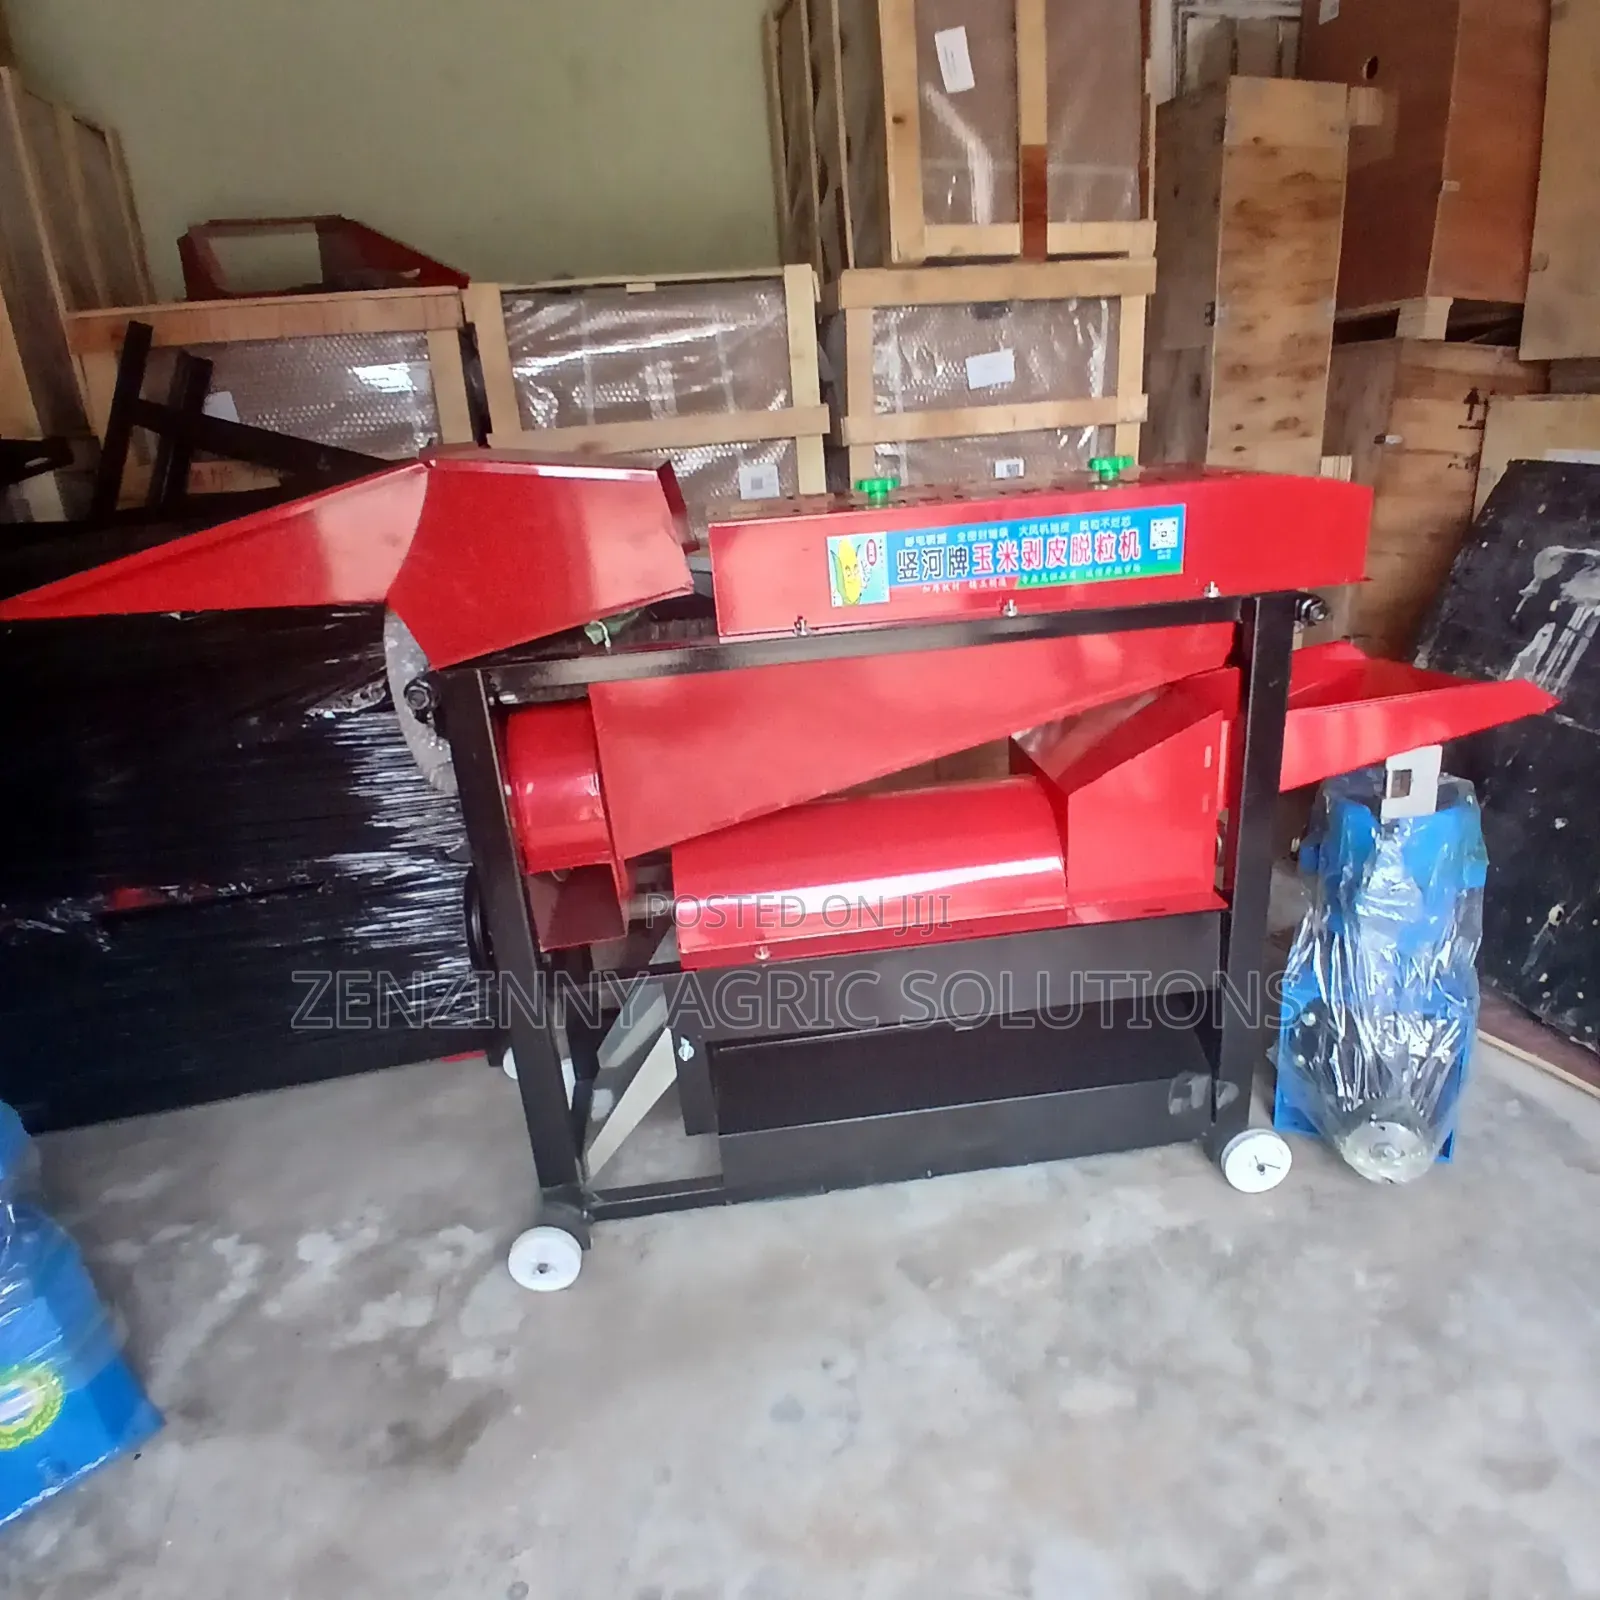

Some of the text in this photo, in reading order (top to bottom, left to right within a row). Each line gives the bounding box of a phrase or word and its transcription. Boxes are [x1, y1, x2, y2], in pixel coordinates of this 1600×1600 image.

[896, 529, 1141, 581] 竖河牌玉米剥皮脱粒机
